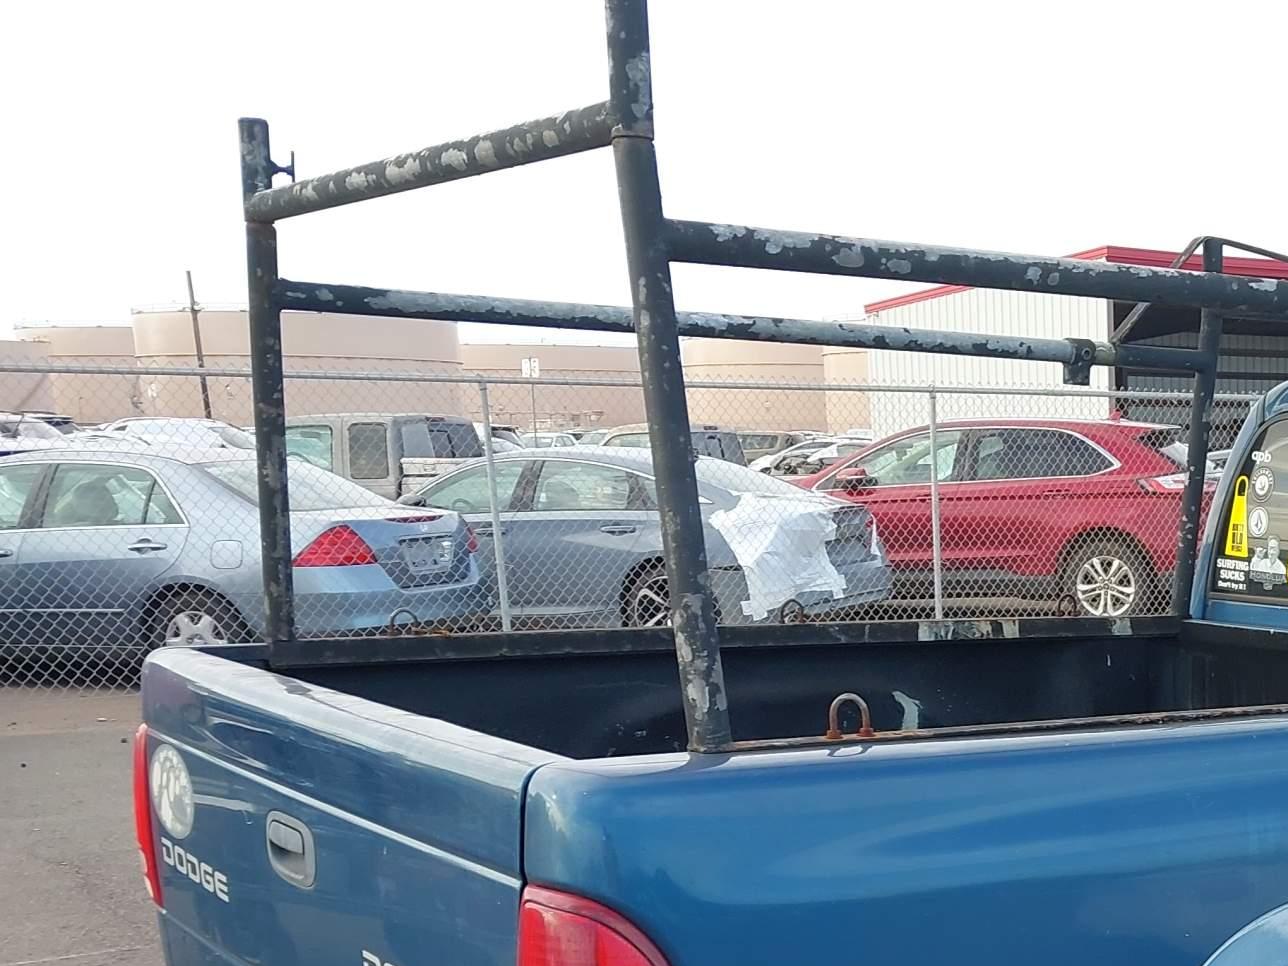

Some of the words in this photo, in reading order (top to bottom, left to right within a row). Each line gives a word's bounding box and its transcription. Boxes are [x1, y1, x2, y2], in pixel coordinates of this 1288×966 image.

[1216, 558, 1249, 571] SURFING
[1220, 569, 1245, 581] SUCKS
[160, 836, 230, 903] DODGE
